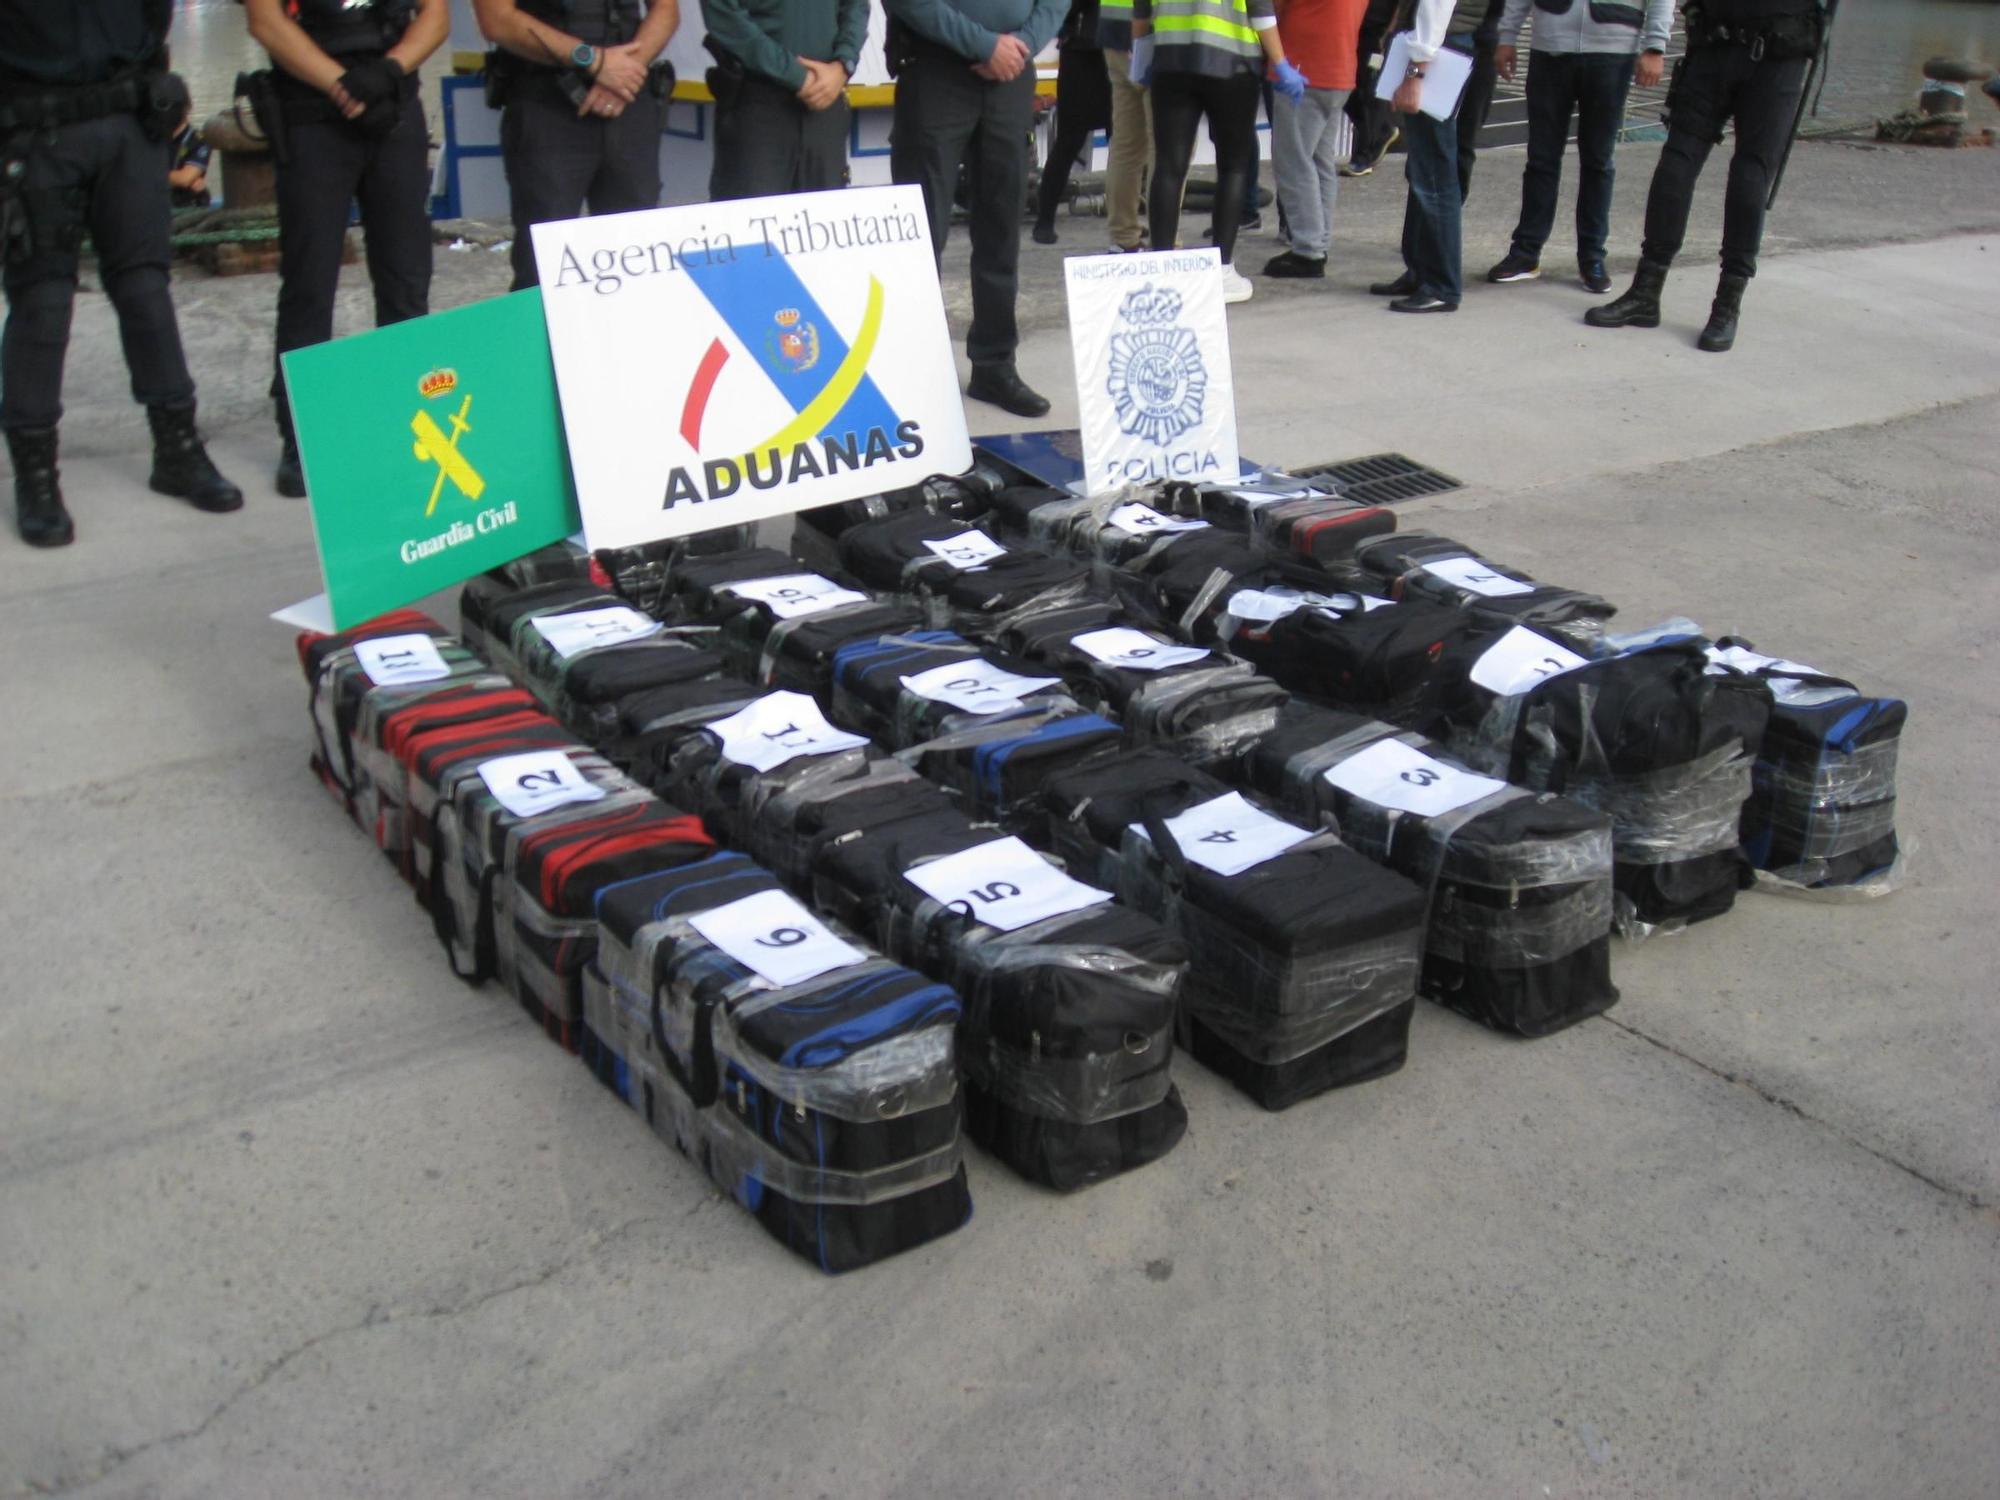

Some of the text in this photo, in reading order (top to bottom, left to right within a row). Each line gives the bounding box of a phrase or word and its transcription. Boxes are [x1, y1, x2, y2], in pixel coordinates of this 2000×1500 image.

[554, 203, 921, 295] Agencia Tributaria
[662, 420, 925, 510] ADUANAS
[400, 500, 518, 564] Guardia Civil
[1401, 768, 1441, 787] 3
[1197, 829, 1239, 844] 4
[969, 881, 1021, 903] 5
